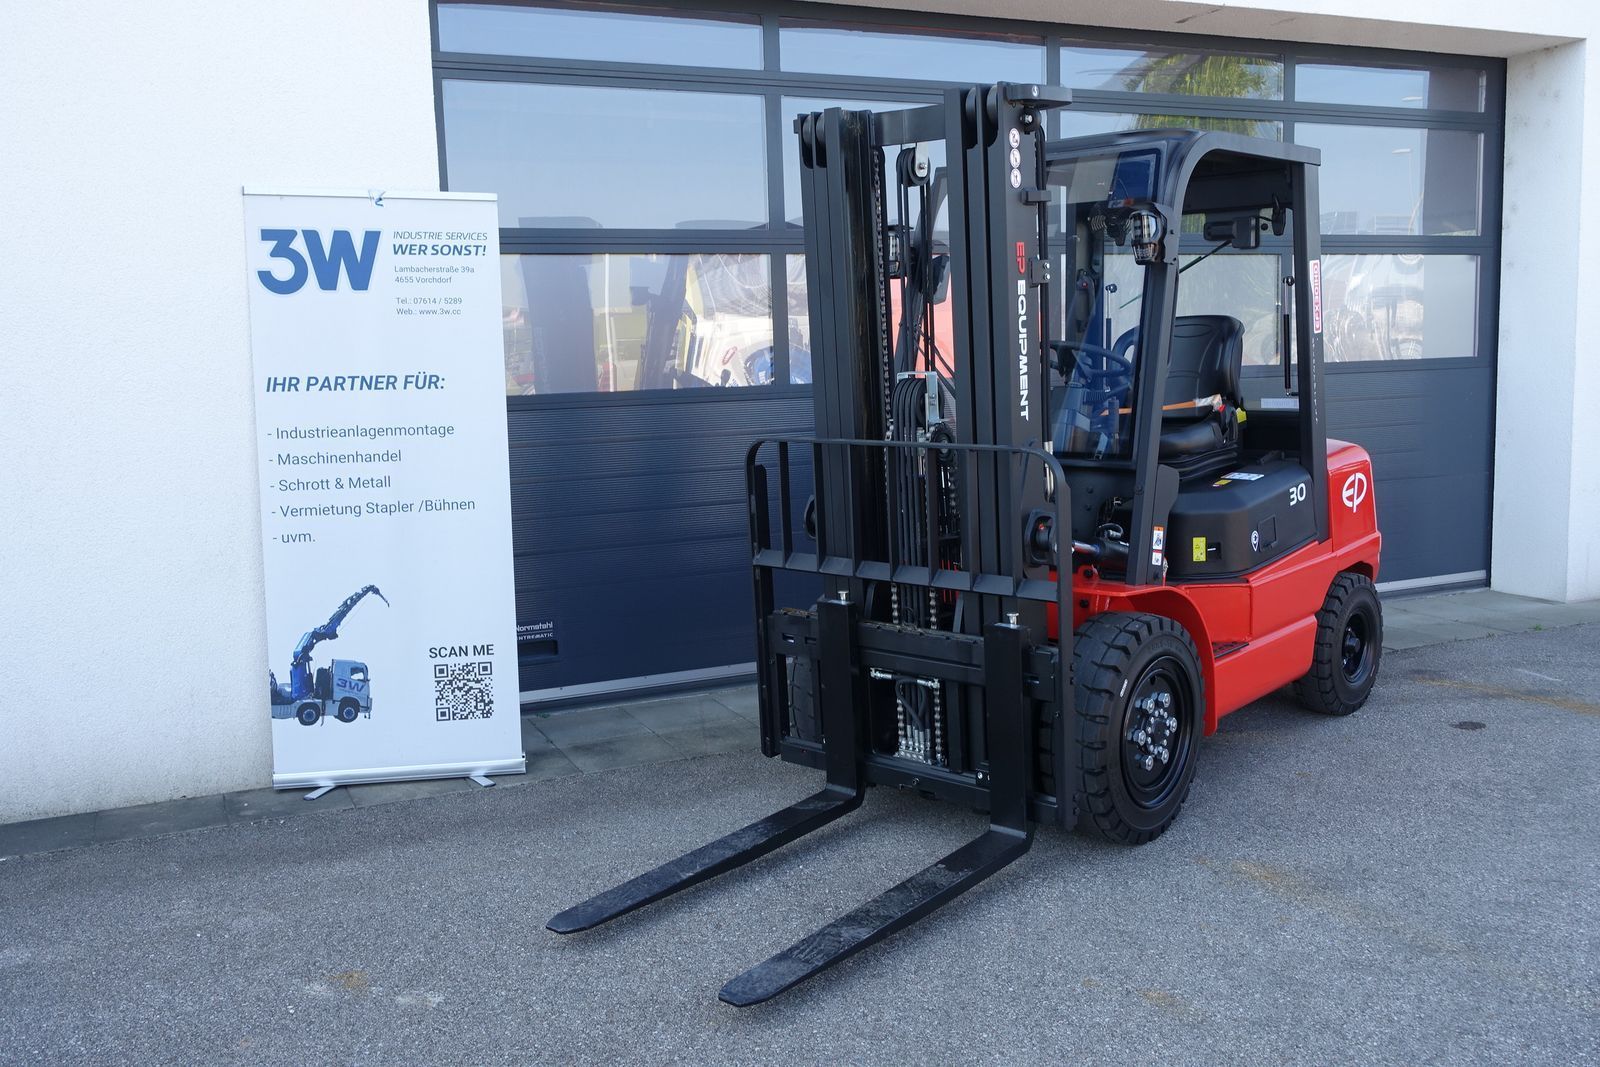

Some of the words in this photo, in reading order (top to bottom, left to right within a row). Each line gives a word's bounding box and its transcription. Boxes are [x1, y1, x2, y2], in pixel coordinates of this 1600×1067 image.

[393, 231, 442, 240] INDUSTRIE
[445, 232, 488, 240] SERVICES
[393, 244, 428, 255] WER
[431, 244, 486, 256] SONST!
[1016, 242, 1026, 274] EP
[257, 229, 381, 294] 3W
[1018, 280, 1029, 422] EQUIPMENT
[266, 376, 300, 392] IHR
[306, 375, 398, 391] PARTNER
[403, 371, 445, 390] FÜR:
[276, 424, 455, 440] Industrieanlagenmontage
[277, 450, 402, 466] Maschinenhandel
[278, 478, 330, 491] Schrott
[334, 477, 344, 490] &
[348, 475, 391, 489] Metall
[1289, 483, 1306, 506] 30
[280, 503, 362, 518] Vermietung
[366, 501, 414, 515] Stapler
[281, 532, 316, 543] uvm.
[517, 632, 553, 640] NTREMATIC
[429, 646, 468, 658] SCAN
[473, 644, 494, 656] ME
